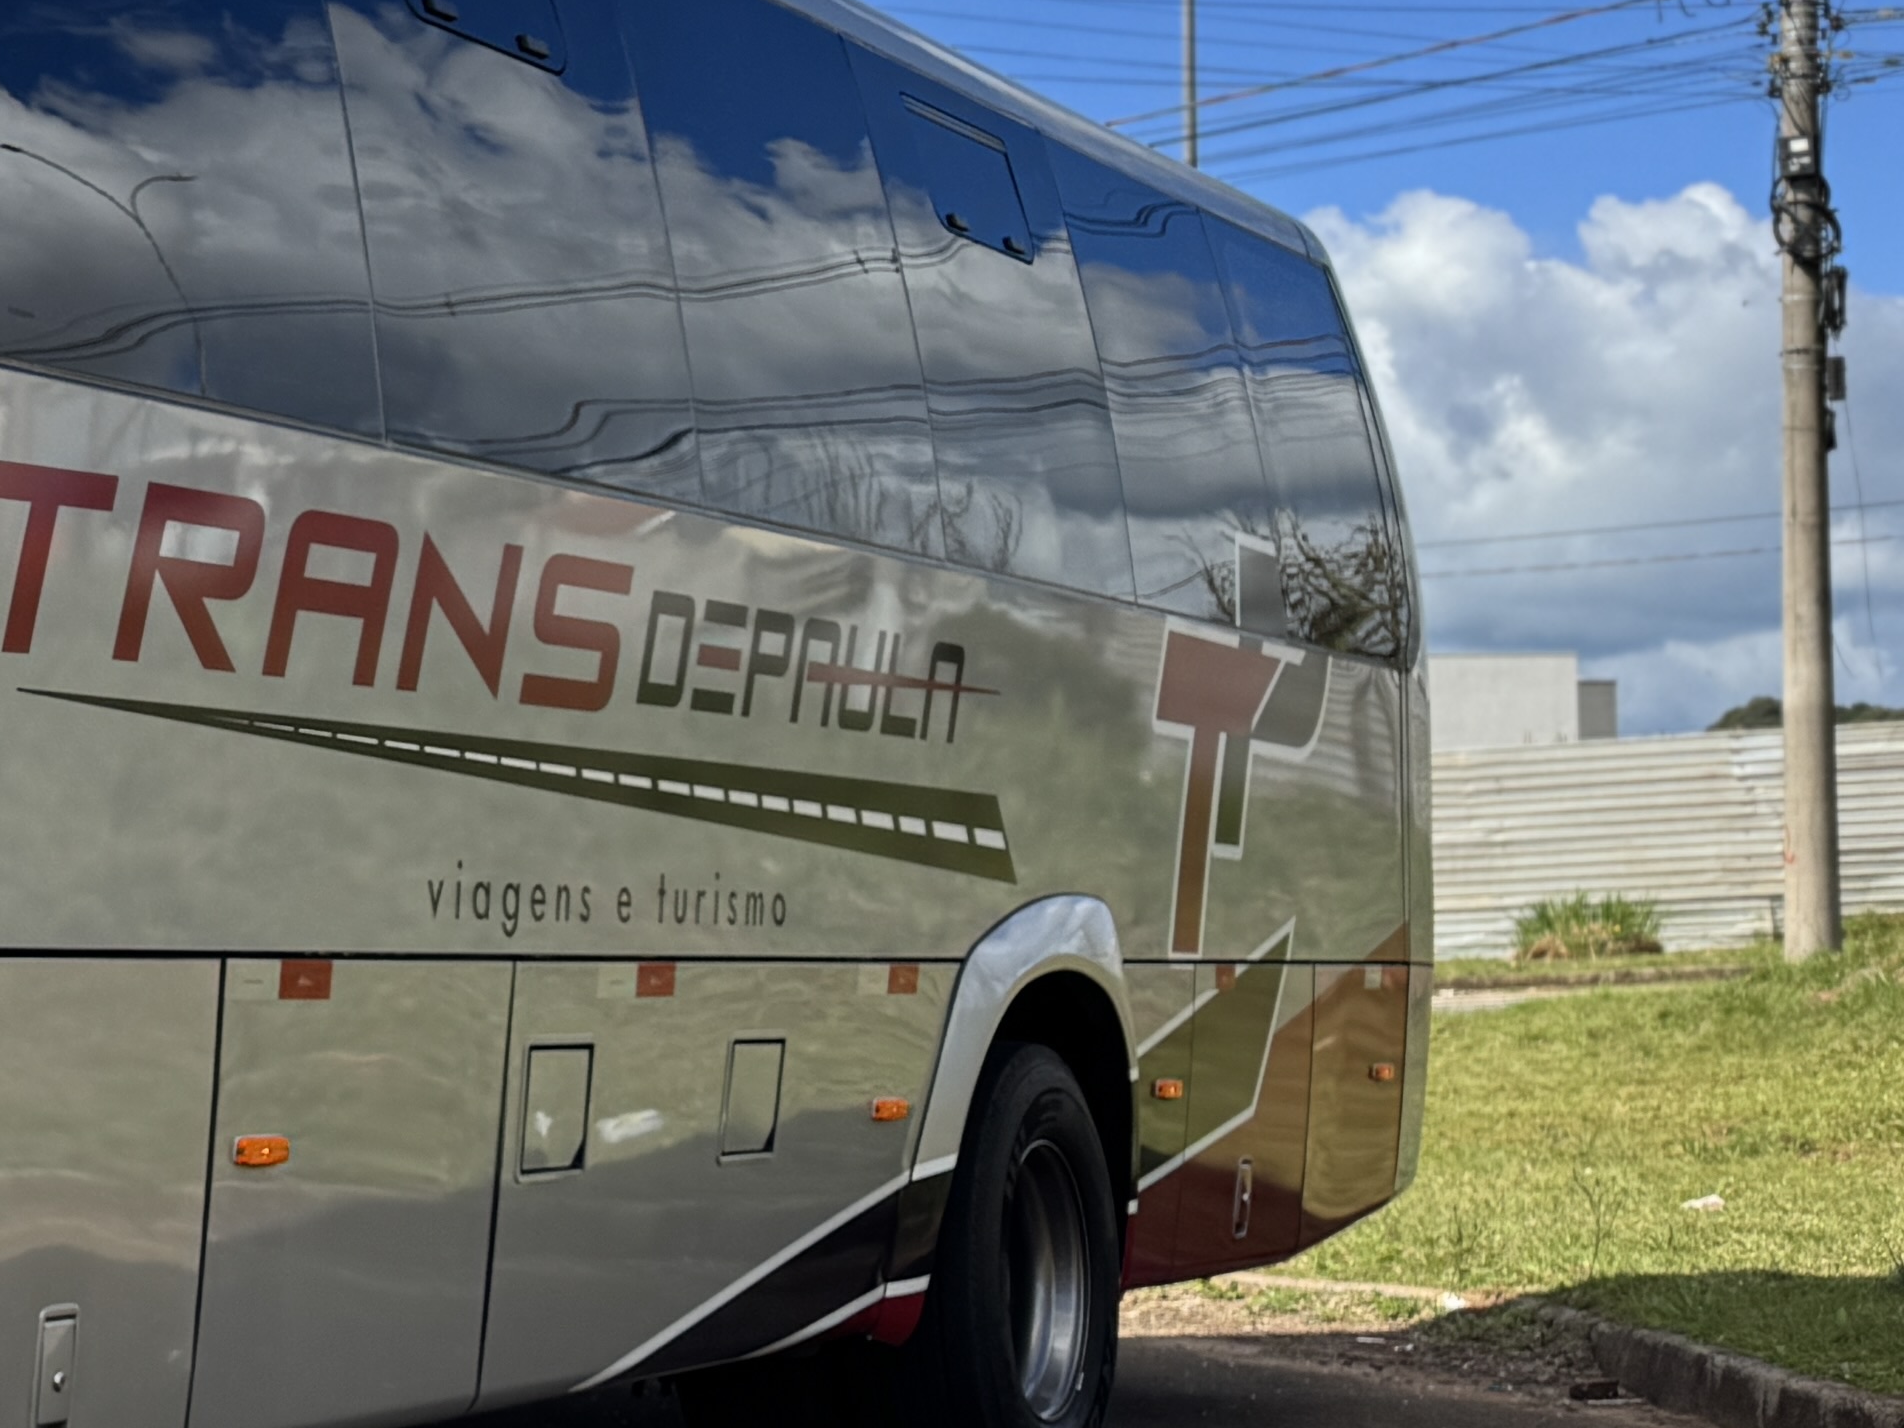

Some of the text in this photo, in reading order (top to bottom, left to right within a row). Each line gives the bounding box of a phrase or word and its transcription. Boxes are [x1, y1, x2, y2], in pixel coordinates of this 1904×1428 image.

[427, 859, 787, 938] viagens e turismo
